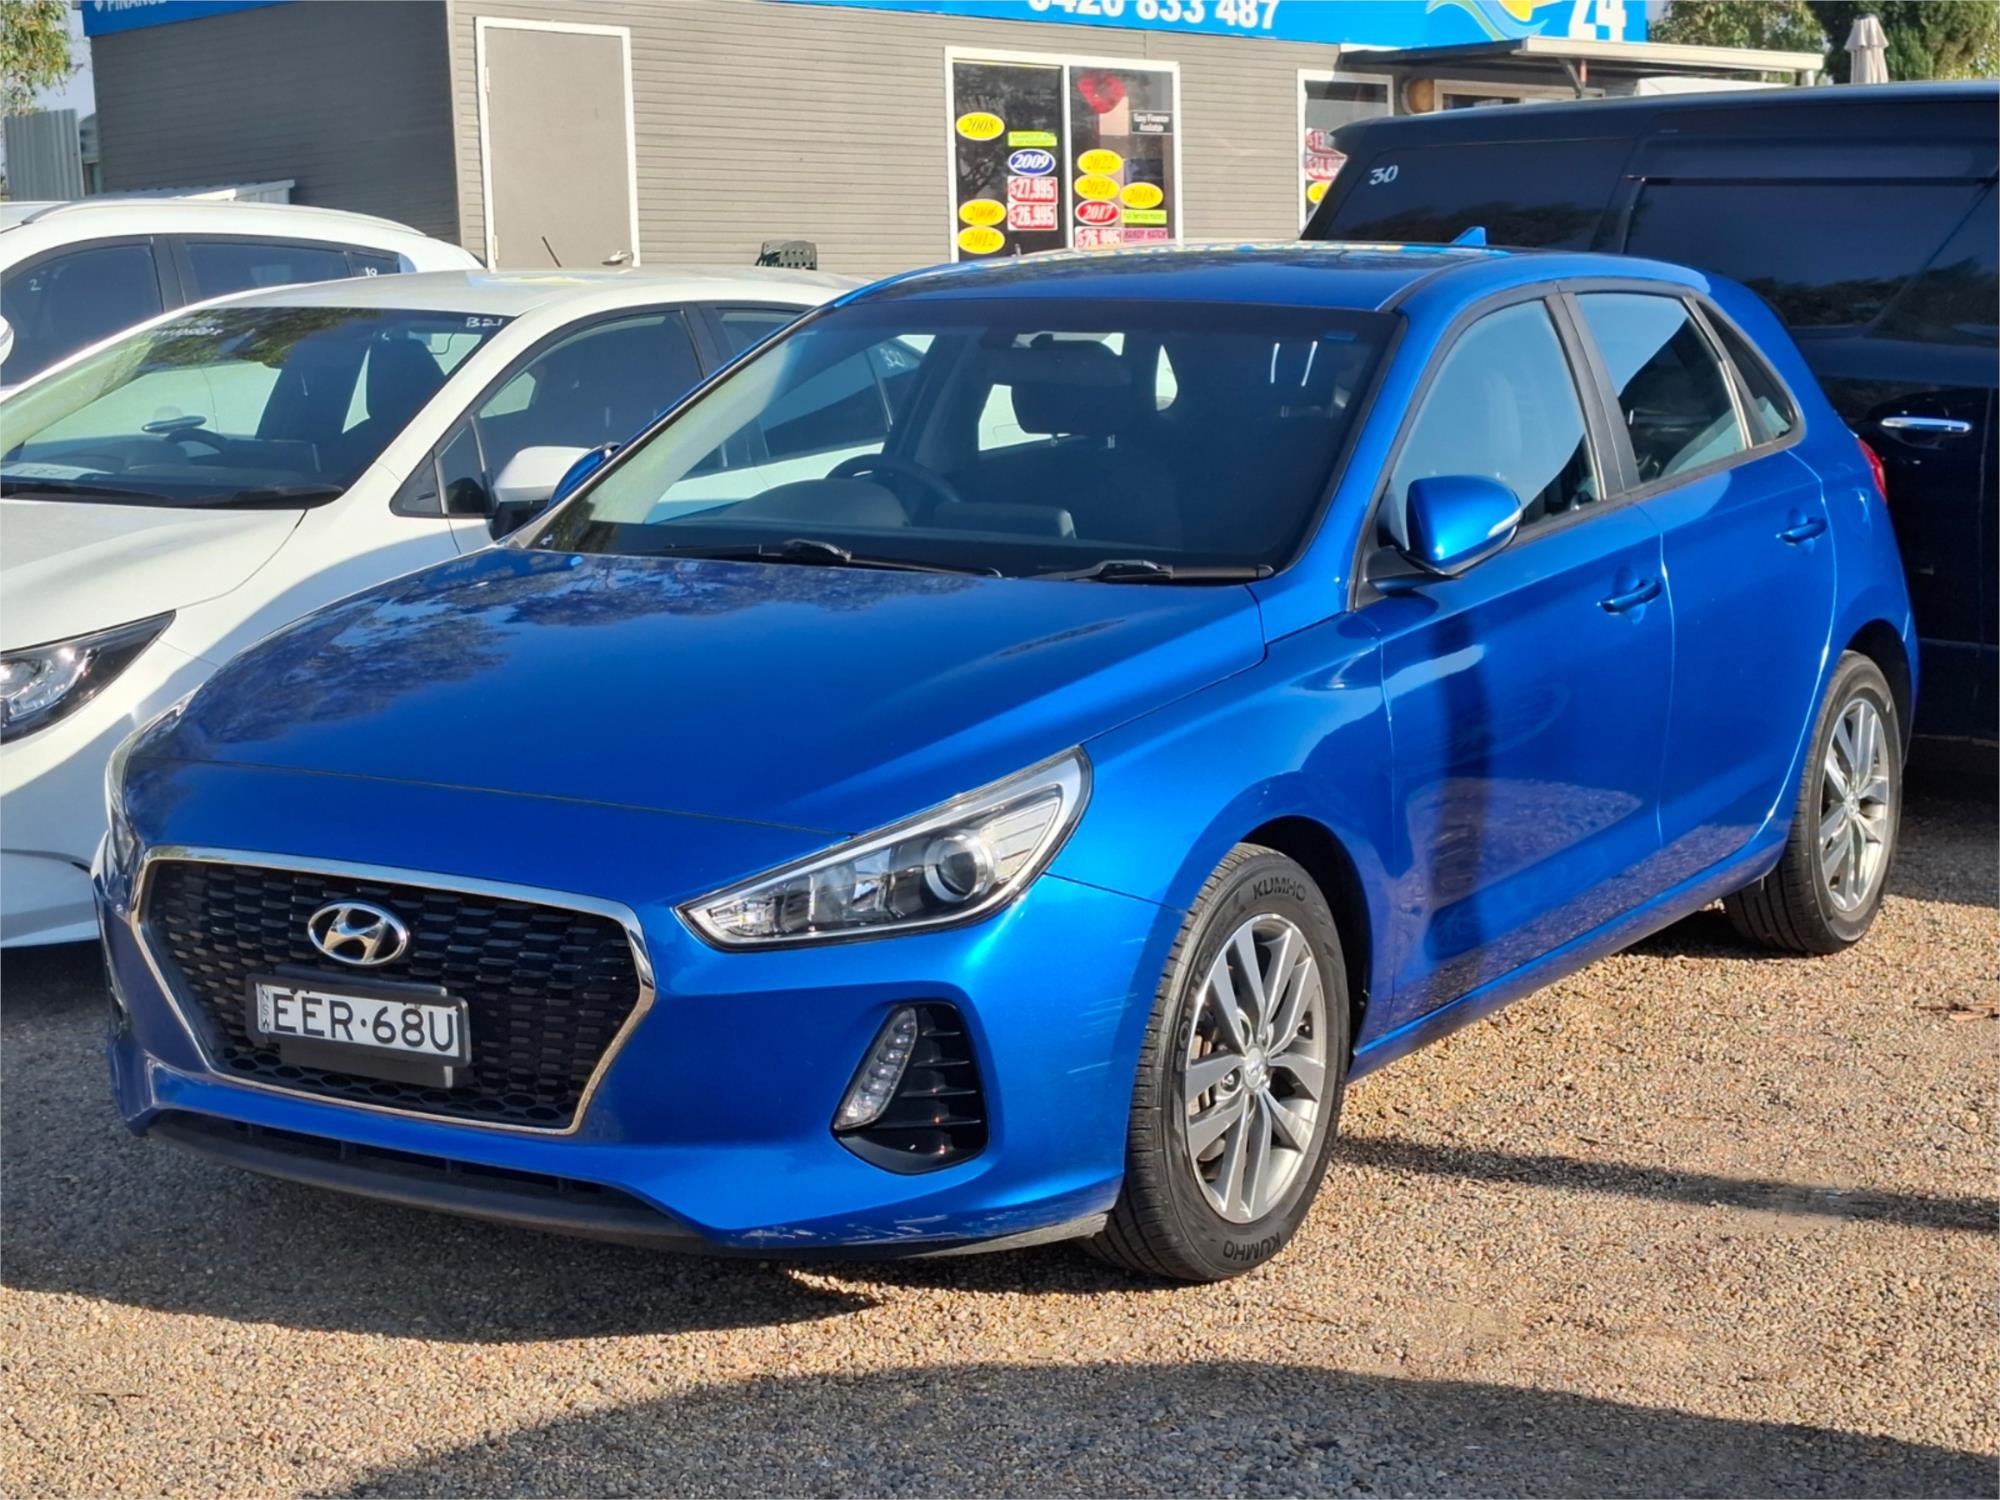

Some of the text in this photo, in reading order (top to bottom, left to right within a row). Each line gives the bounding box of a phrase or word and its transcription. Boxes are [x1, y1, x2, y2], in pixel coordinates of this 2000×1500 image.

[107, 0, 167, 12] FINA
[1215, 0, 1280, 29] 487
[1013, 153, 1050, 169] 2009
[1369, 164, 1399, 185] 30
[1083, 204, 1113, 220] 2017
[1251, 876, 1307, 902] KUMHO
[1222, 1231, 1281, 1261] KUMHO
